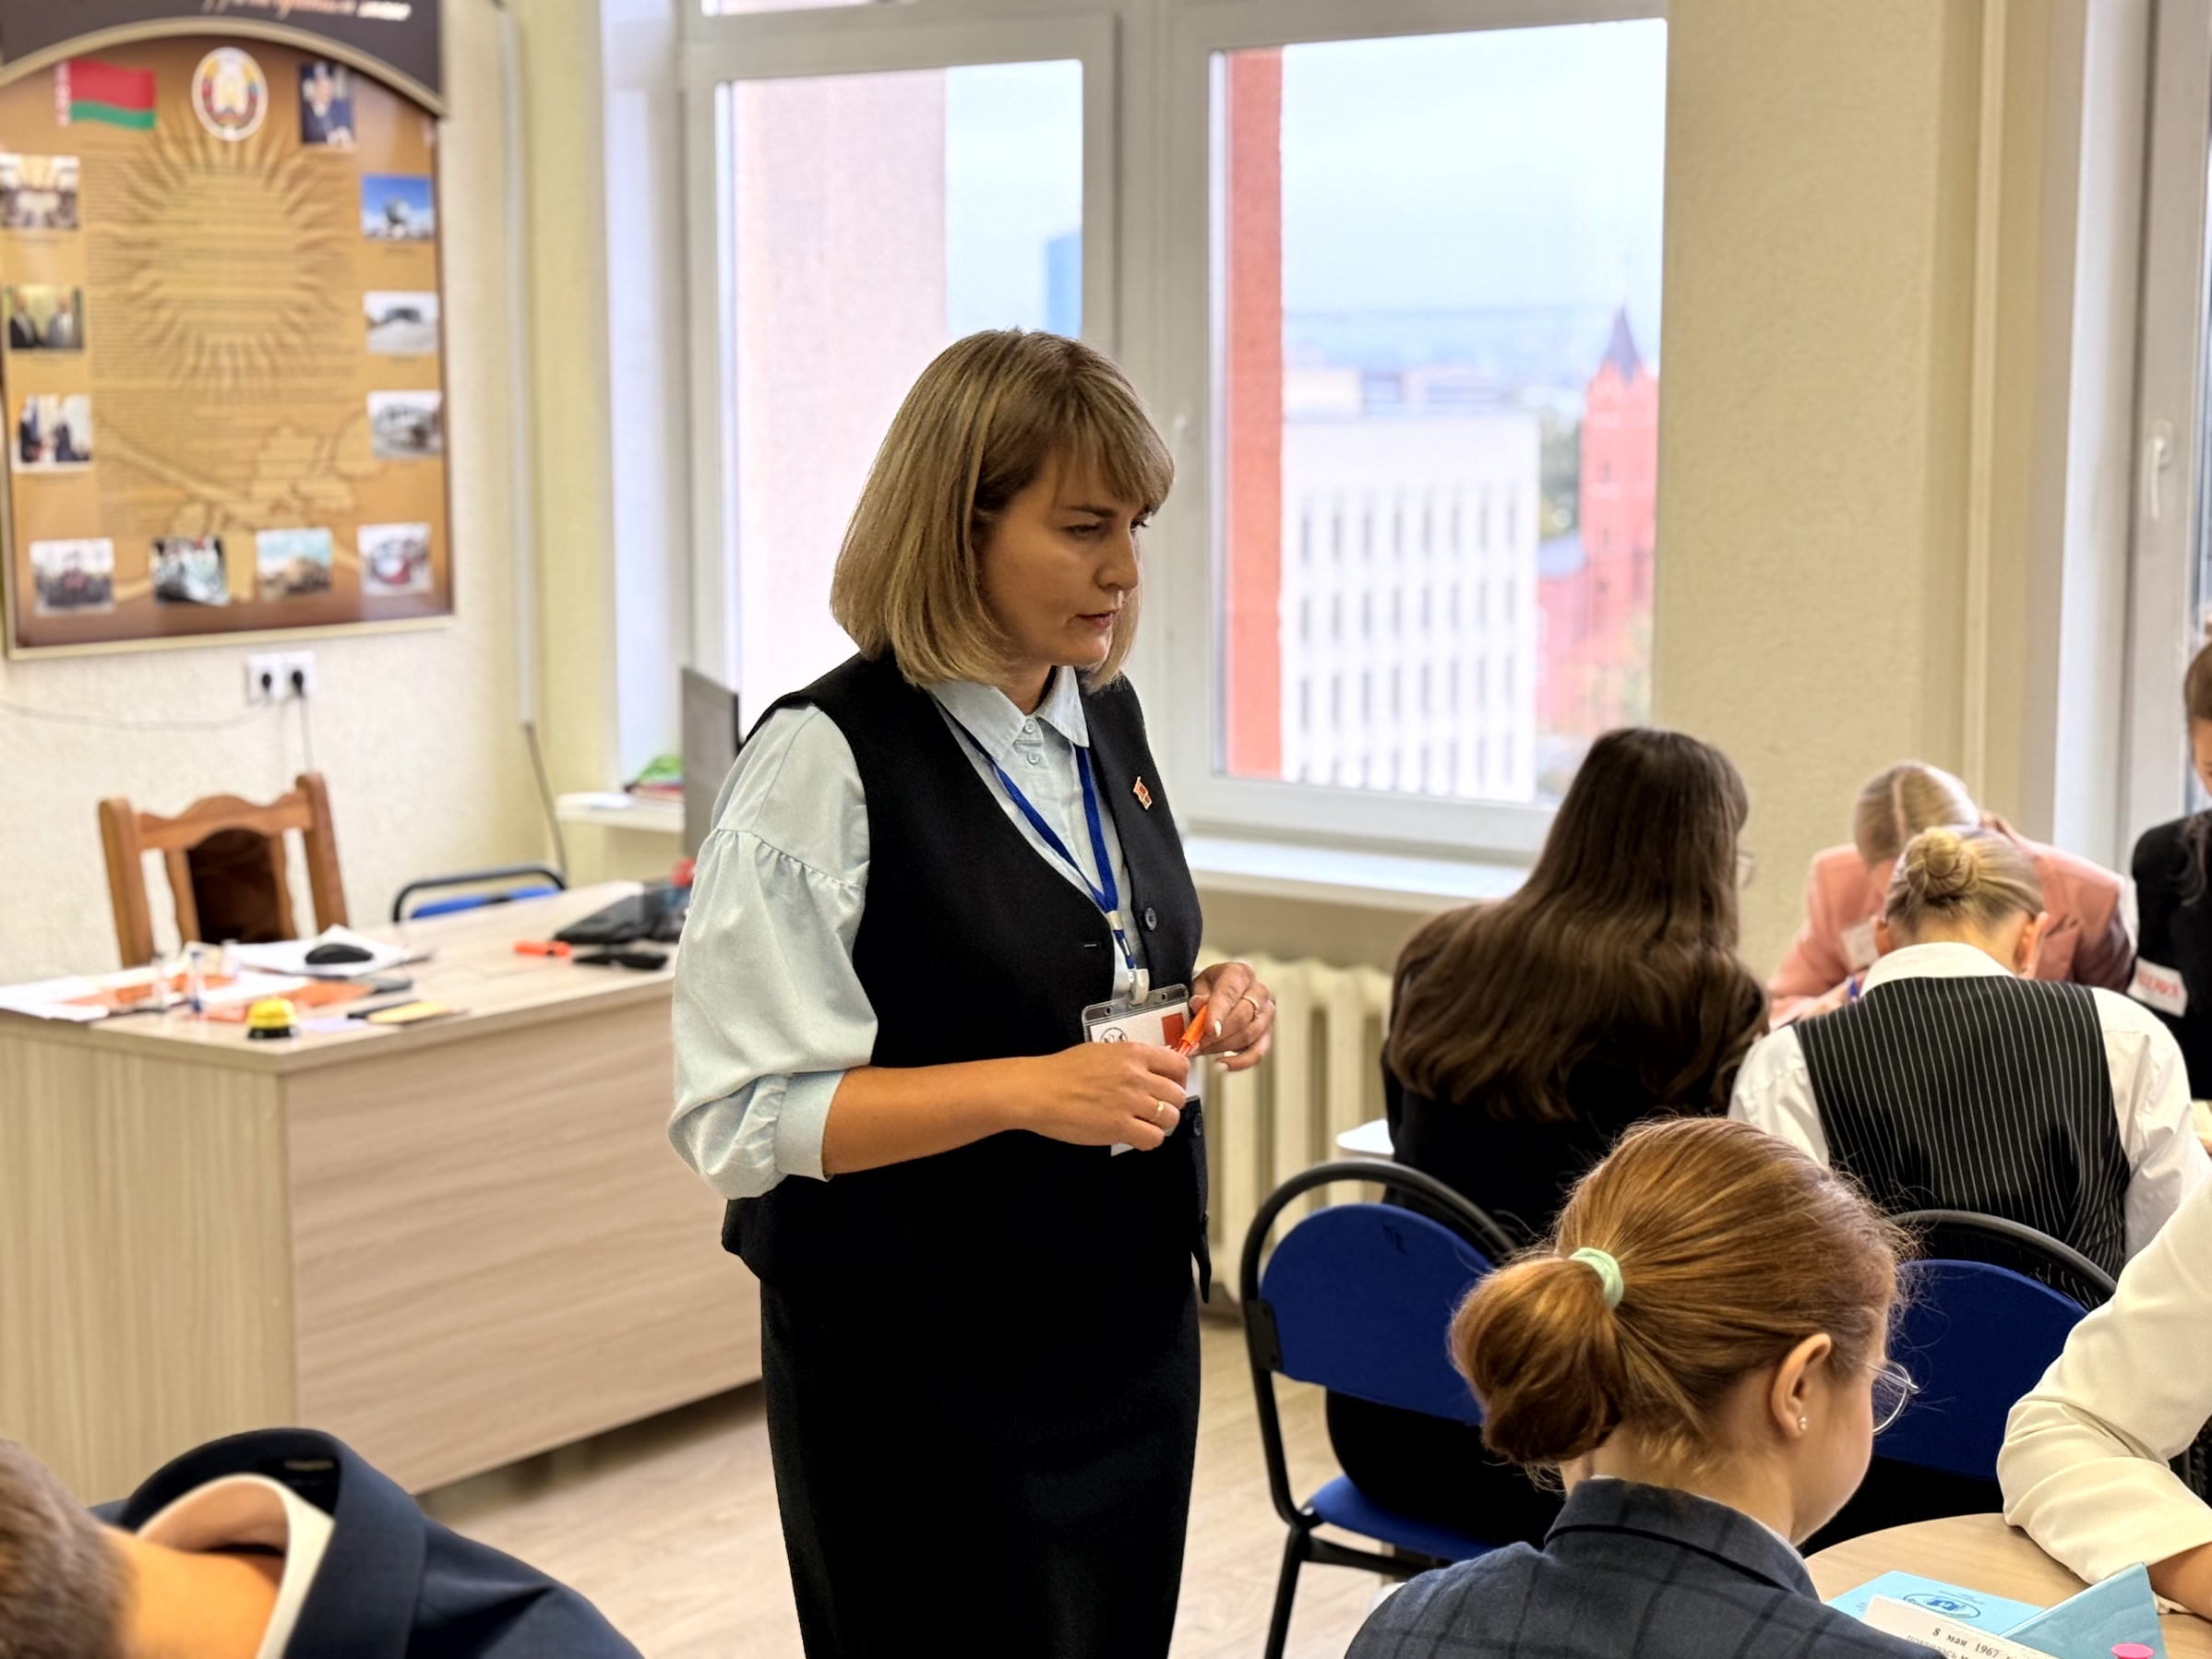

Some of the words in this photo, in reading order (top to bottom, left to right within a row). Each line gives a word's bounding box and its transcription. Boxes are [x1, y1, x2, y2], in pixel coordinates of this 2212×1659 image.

[1932, 1627, 1942, 1637] 8
[1946, 1634, 1967, 1648] мая
[1975, 1642, 2000, 1658] 1967
